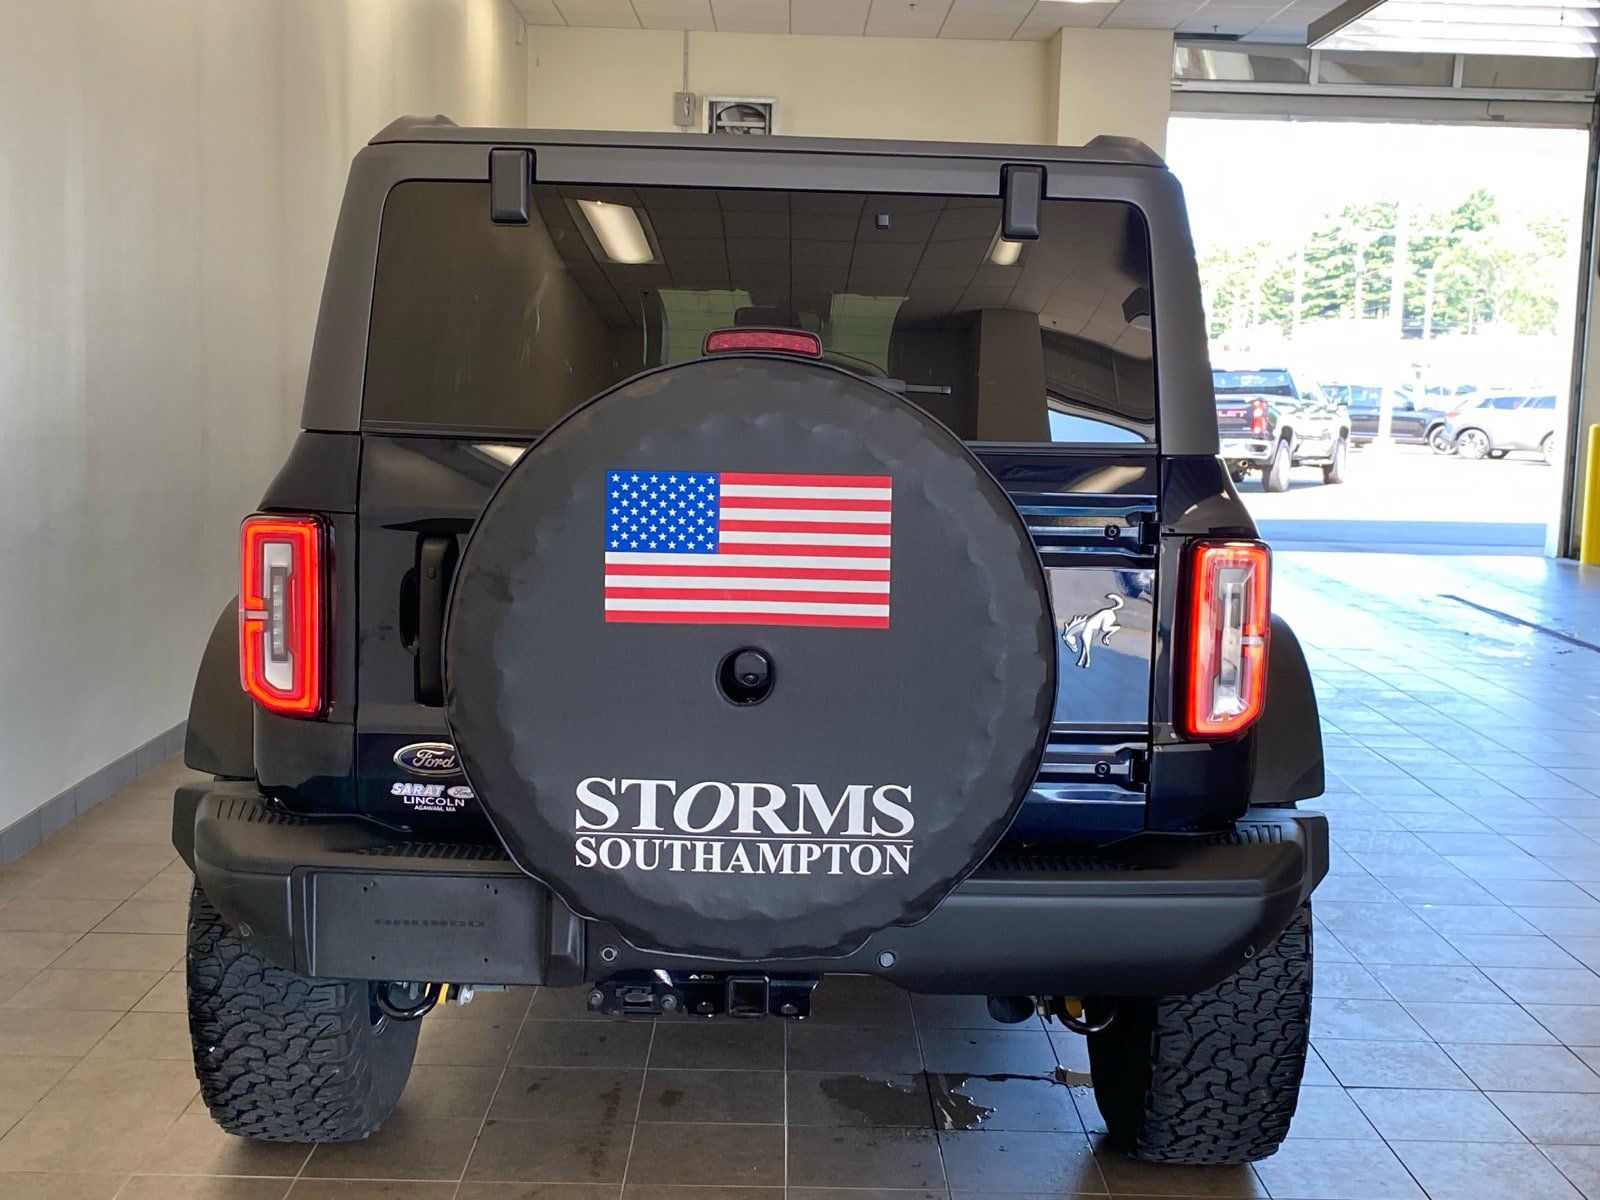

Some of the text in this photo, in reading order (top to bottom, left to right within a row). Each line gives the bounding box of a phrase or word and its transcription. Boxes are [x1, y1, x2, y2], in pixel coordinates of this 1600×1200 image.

[1216, 410, 1247, 418] LET
[412, 749, 455, 768] Ford
[391, 782, 445, 797] SARAT
[403, 796, 465, 807] LINCOLN
[575, 777, 915, 837] STORMS
[575, 837, 913, 875] SOUTHAMPTON
